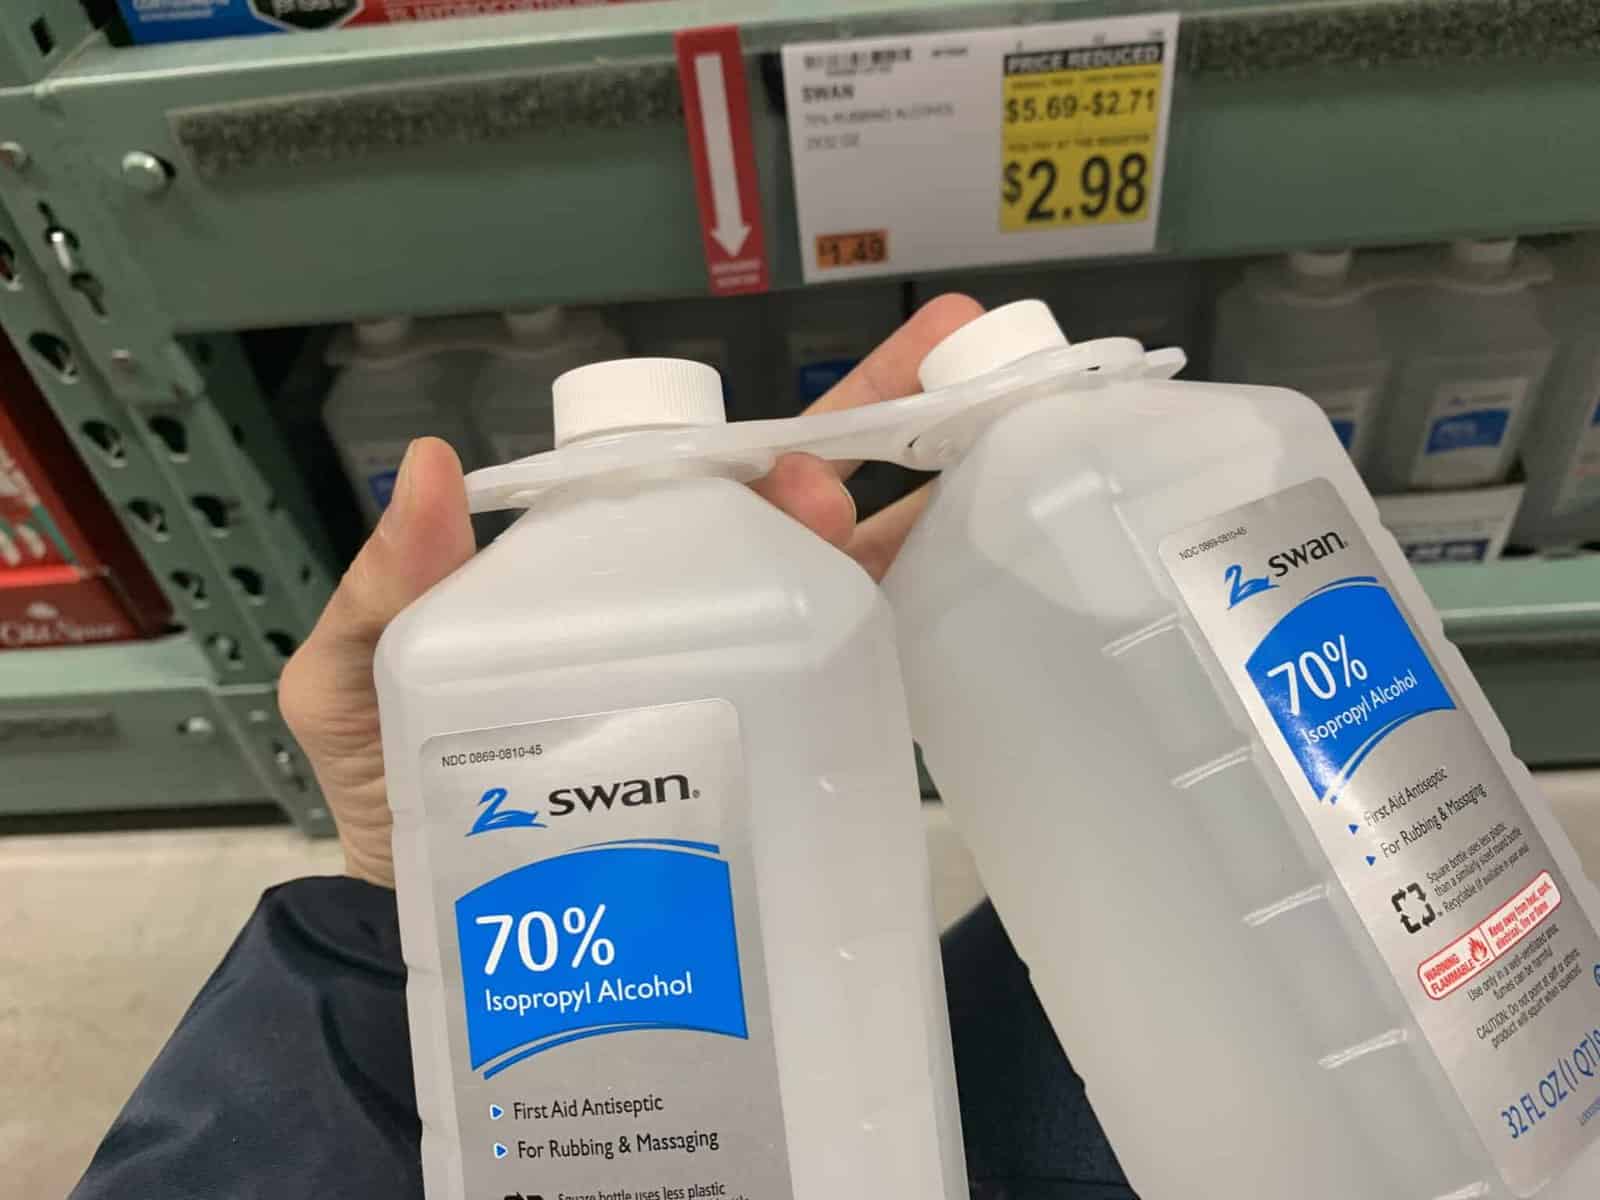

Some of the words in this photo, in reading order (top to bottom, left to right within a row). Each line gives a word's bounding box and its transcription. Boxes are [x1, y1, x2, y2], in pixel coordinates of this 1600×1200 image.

[1008, 54, 1063, 73] PRICE
[1067, 45, 1161, 69] REDUCED
[802, 84, 854, 103] SWAN
[1003, 153, 1148, 223] $2.98
[1179, 546, 1200, 561] NDC
[1267, 531, 1345, 577] swan
[1267, 634, 1368, 716] 70%
[1301, 698, 1369, 746] Isopropyl
[1369, 669, 1418, 709] Alcohol
[442, 752, 467, 767] NDC
[469, 744, 543, 764] 0869-0810-45
[548, 774, 691, 816] swan
[1364, 803, 1390, 827] First
[1388, 789, 1406, 815] Aid
[1405, 766, 1448, 803] Antiseptic
[1380, 840, 1401, 859] For
[1400, 815, 1443, 846] Rubbing
[1437, 806, 1448, 822] &
[1448, 783, 1488, 813] Massaging
[475, 904, 615, 976] 70%
[1424, 952, 1459, 982] WARNING
[1430, 957, 1476, 995] FLAMMABLE
[485, 982, 592, 1016] Isopropyl
[598, 971, 693, 1003] Alcohol
[513, 1102, 549, 1121] First
[551, 1099, 578, 1118] Aid
[581, 1094, 664, 1118] Antiseptic
[1502, 1104, 1529, 1139] 32
[1519, 1092, 1546, 1125] FL
[1539, 1069, 1568, 1108] OZ
[518, 1141, 544, 1159] For
[550, 1138, 614, 1160] Rubbing
[619, 1135, 631, 1154] &
[637, 1130, 720, 1152] Massaging
[635, 1188, 661, 1200] uses
[662, 1186, 686, 1199] less
[687, 1181, 726, 1199] plastic
